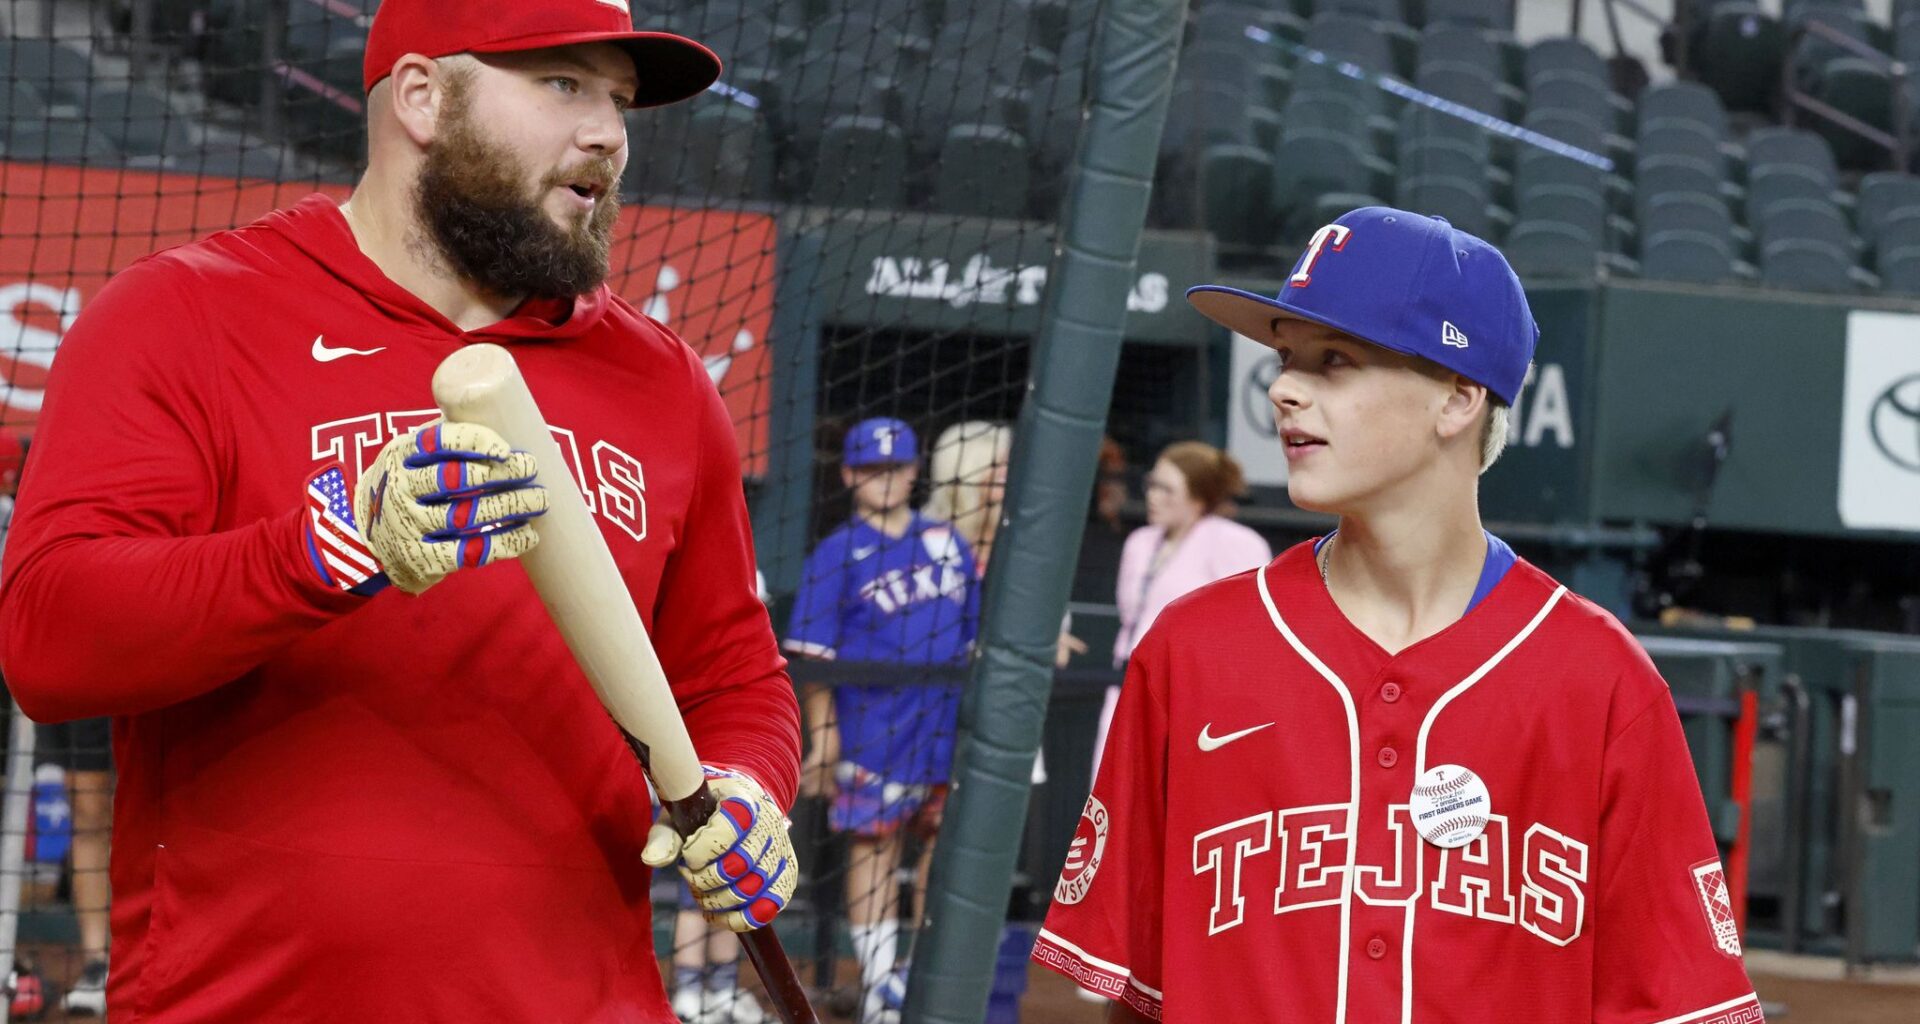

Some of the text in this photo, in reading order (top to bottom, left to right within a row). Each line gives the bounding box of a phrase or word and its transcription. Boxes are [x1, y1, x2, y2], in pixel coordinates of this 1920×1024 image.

[1290, 224, 1352, 288] T
[1435, 770, 1445, 781] T
[1418, 795, 1483, 821] FIRST RANGERS GAME
[1193, 802, 1589, 947] TEJAS
